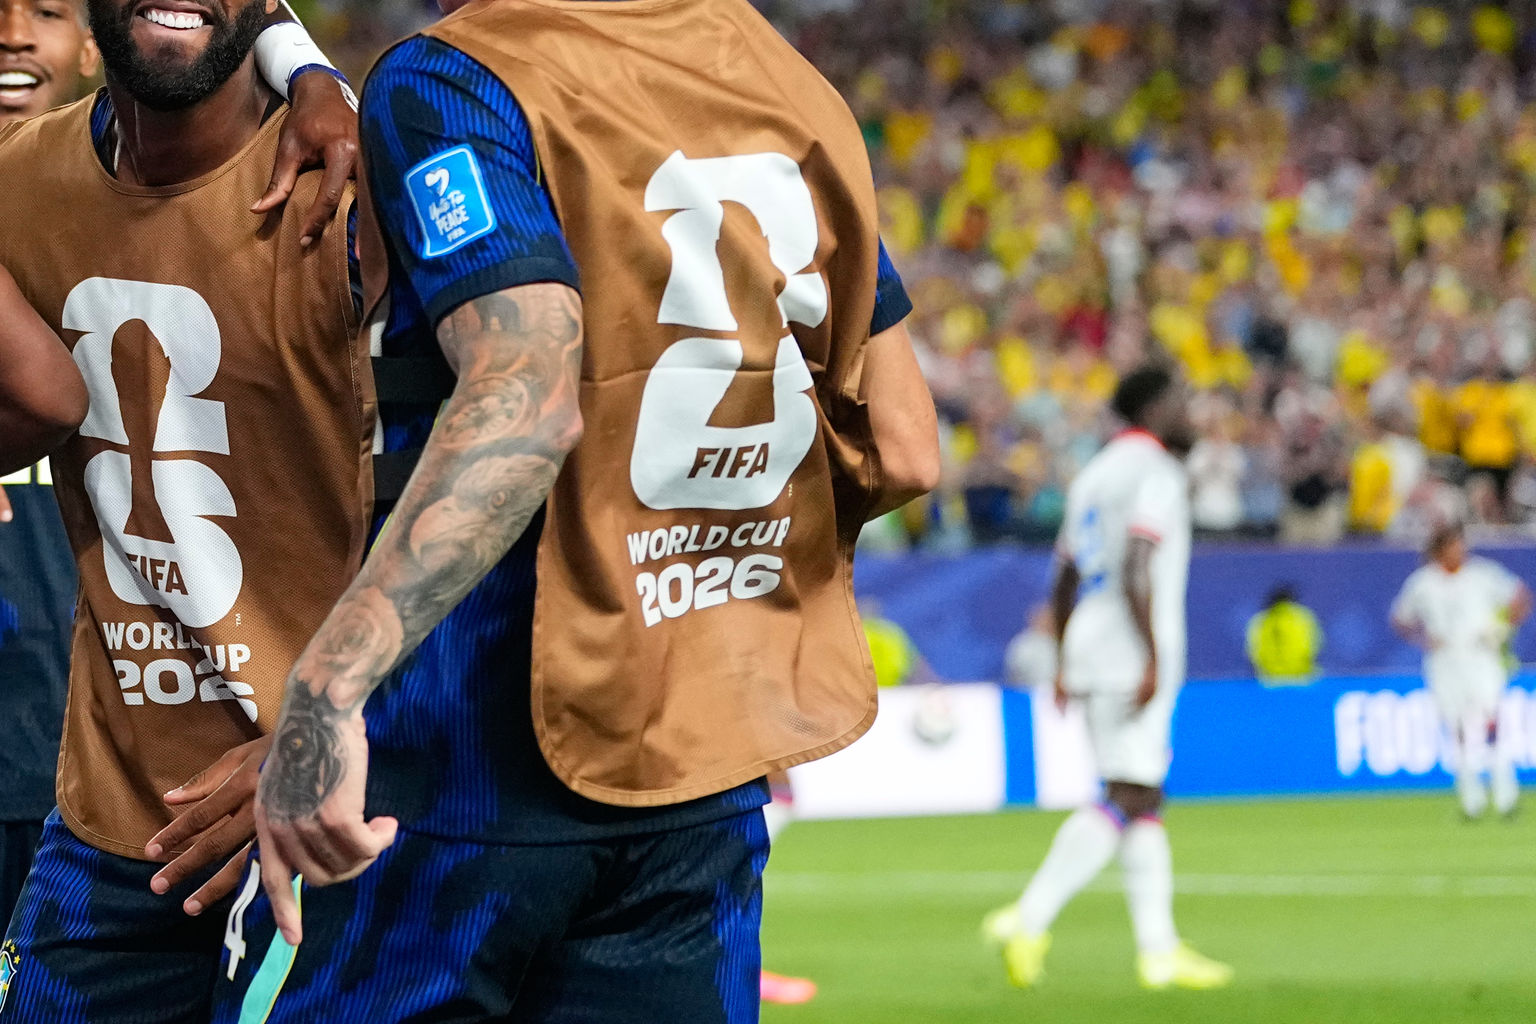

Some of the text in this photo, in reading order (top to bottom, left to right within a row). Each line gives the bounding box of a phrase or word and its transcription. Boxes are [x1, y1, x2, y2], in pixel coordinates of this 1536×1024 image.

[687, 442, 770, 480] FIFA
[626, 516, 792, 566] WORLD CUP
[635, 553, 784, 628] 2026
[202, 643, 251, 673] UP
